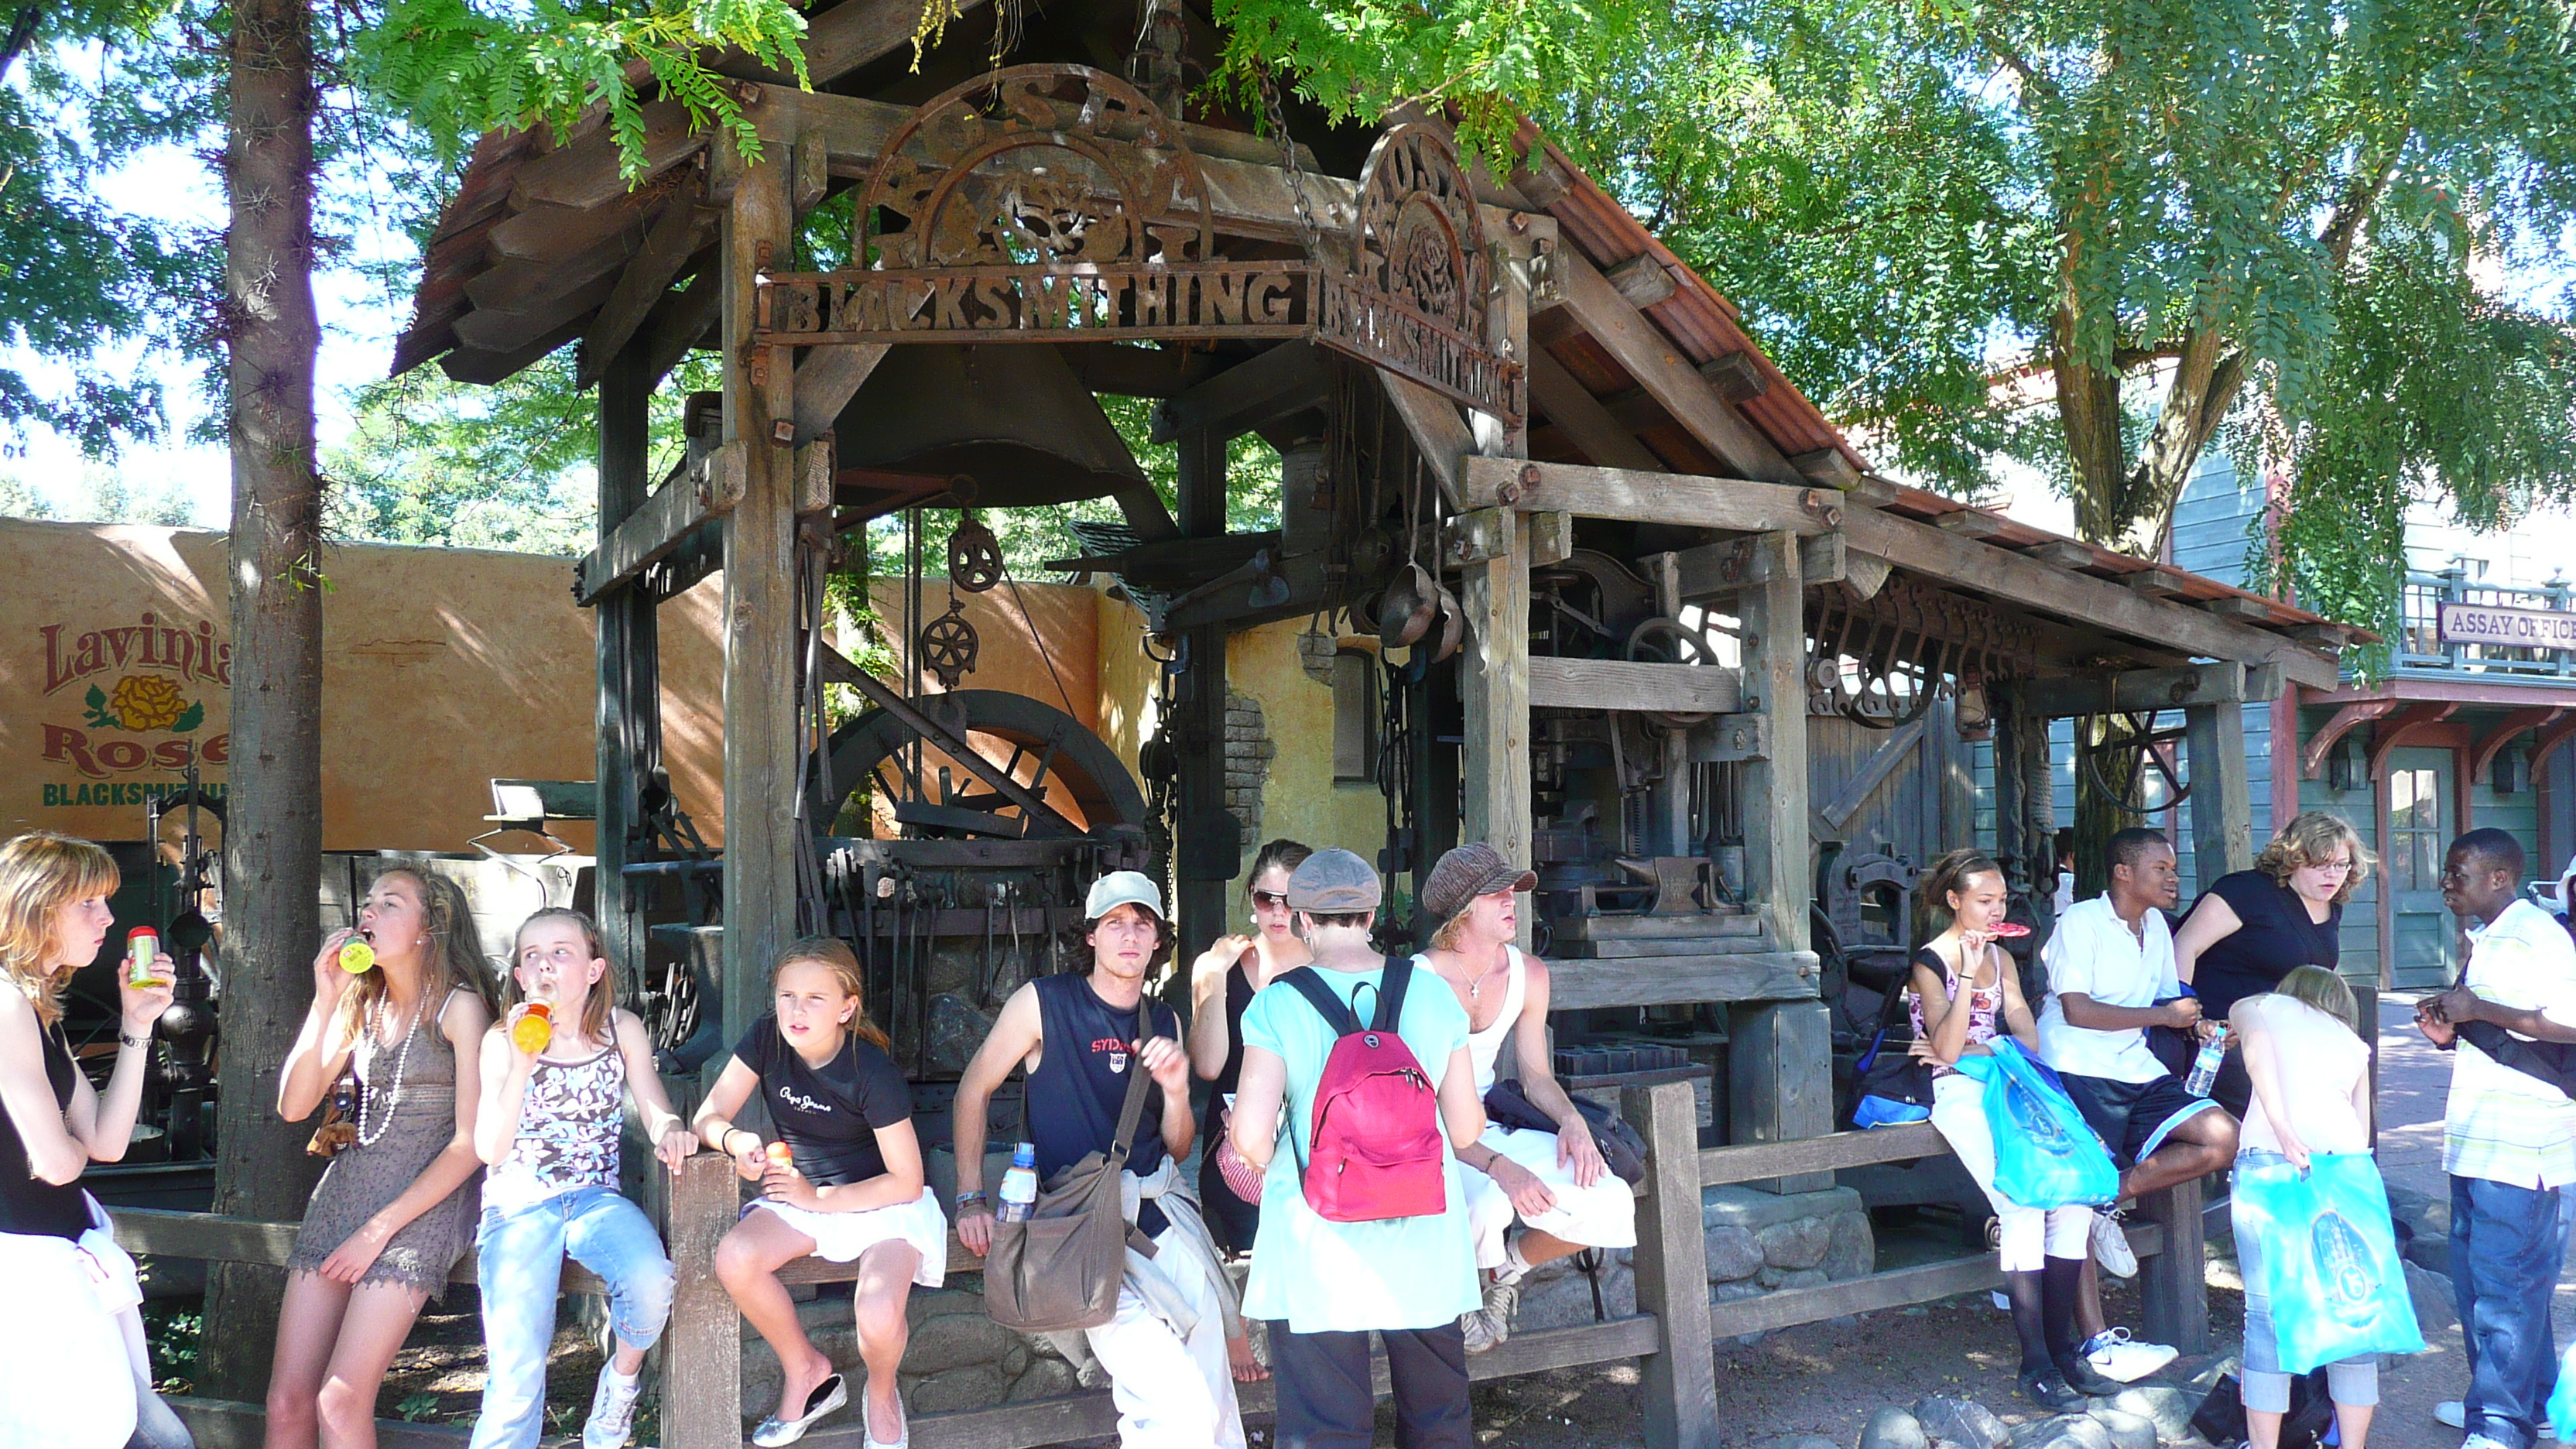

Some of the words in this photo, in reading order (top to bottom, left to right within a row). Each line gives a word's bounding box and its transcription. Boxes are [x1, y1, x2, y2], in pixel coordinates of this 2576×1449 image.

[785, 272, 1293, 333] BLACKSMITHING
[2452, 611, 2513, 635] ASSAY
[2518, 616, 2576, 640] OFFICE
[41, 722, 229, 779] Rose
[43, 783, 229, 807] BLACKSMII
